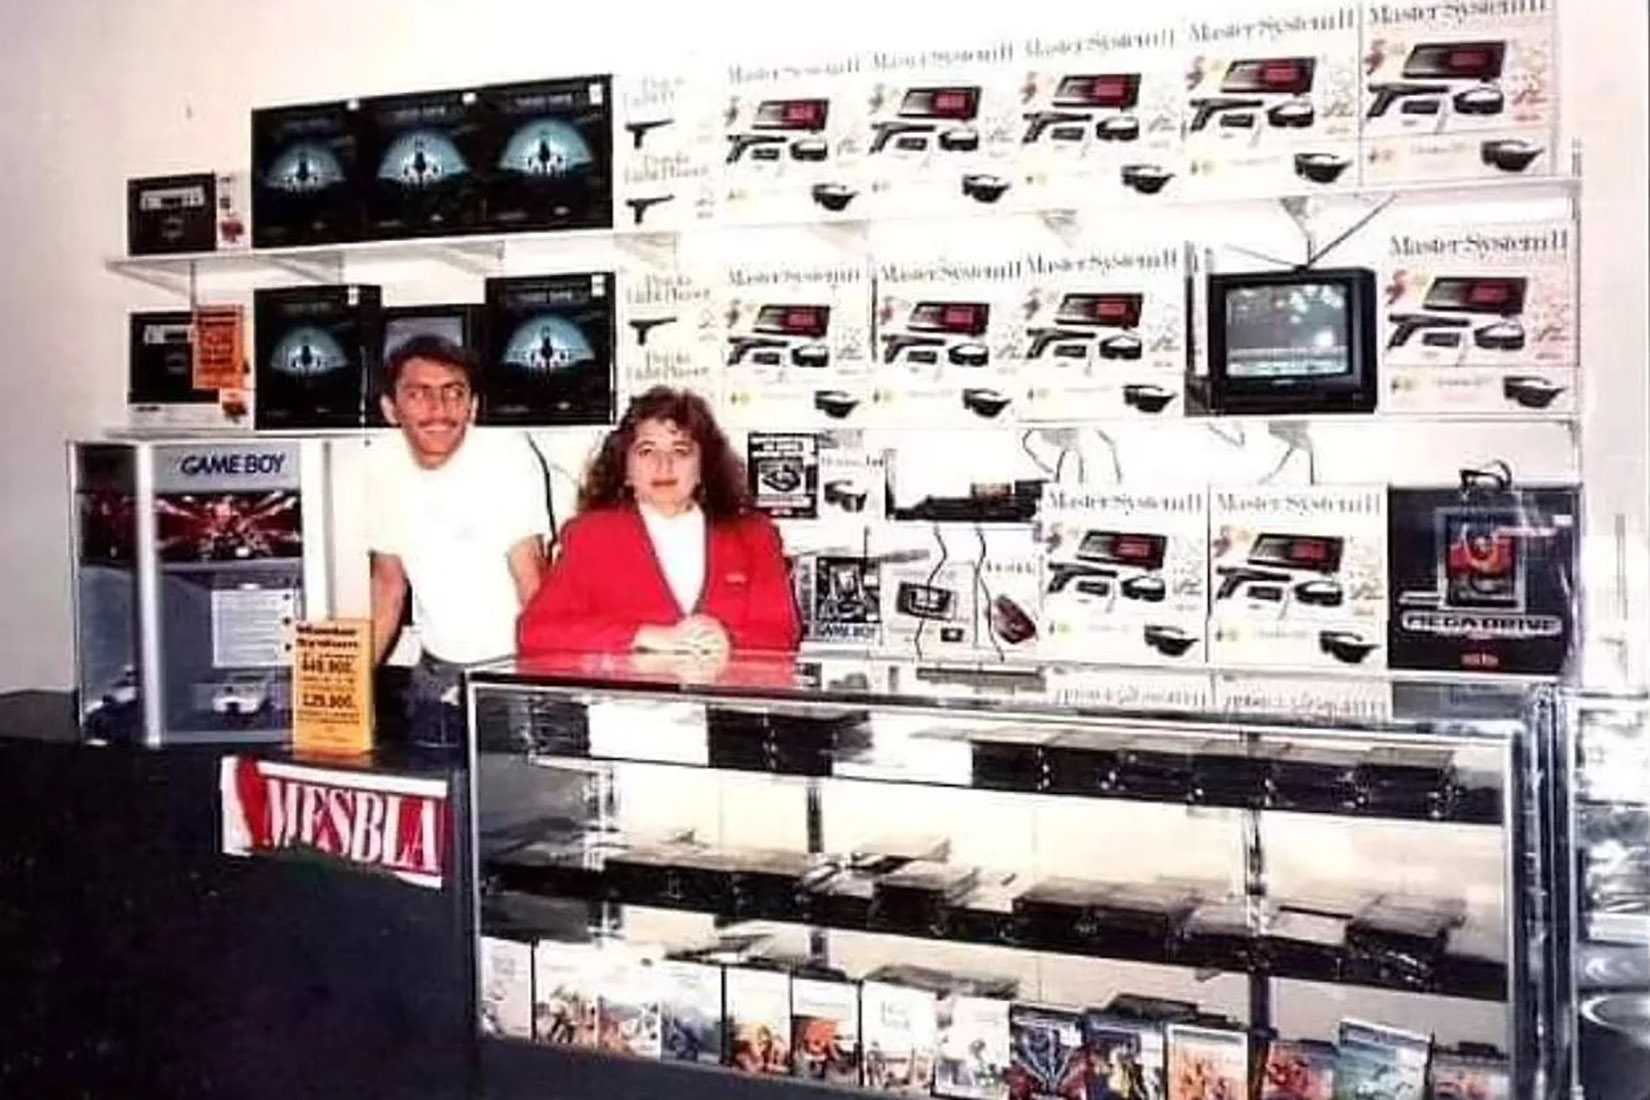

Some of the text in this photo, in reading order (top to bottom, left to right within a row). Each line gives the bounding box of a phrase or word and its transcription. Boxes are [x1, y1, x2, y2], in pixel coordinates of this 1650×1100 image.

[1389, 234, 1457, 256] Master
[181, 453, 286, 475] GAME BOY
[264, 778, 437, 871] MESBLA
